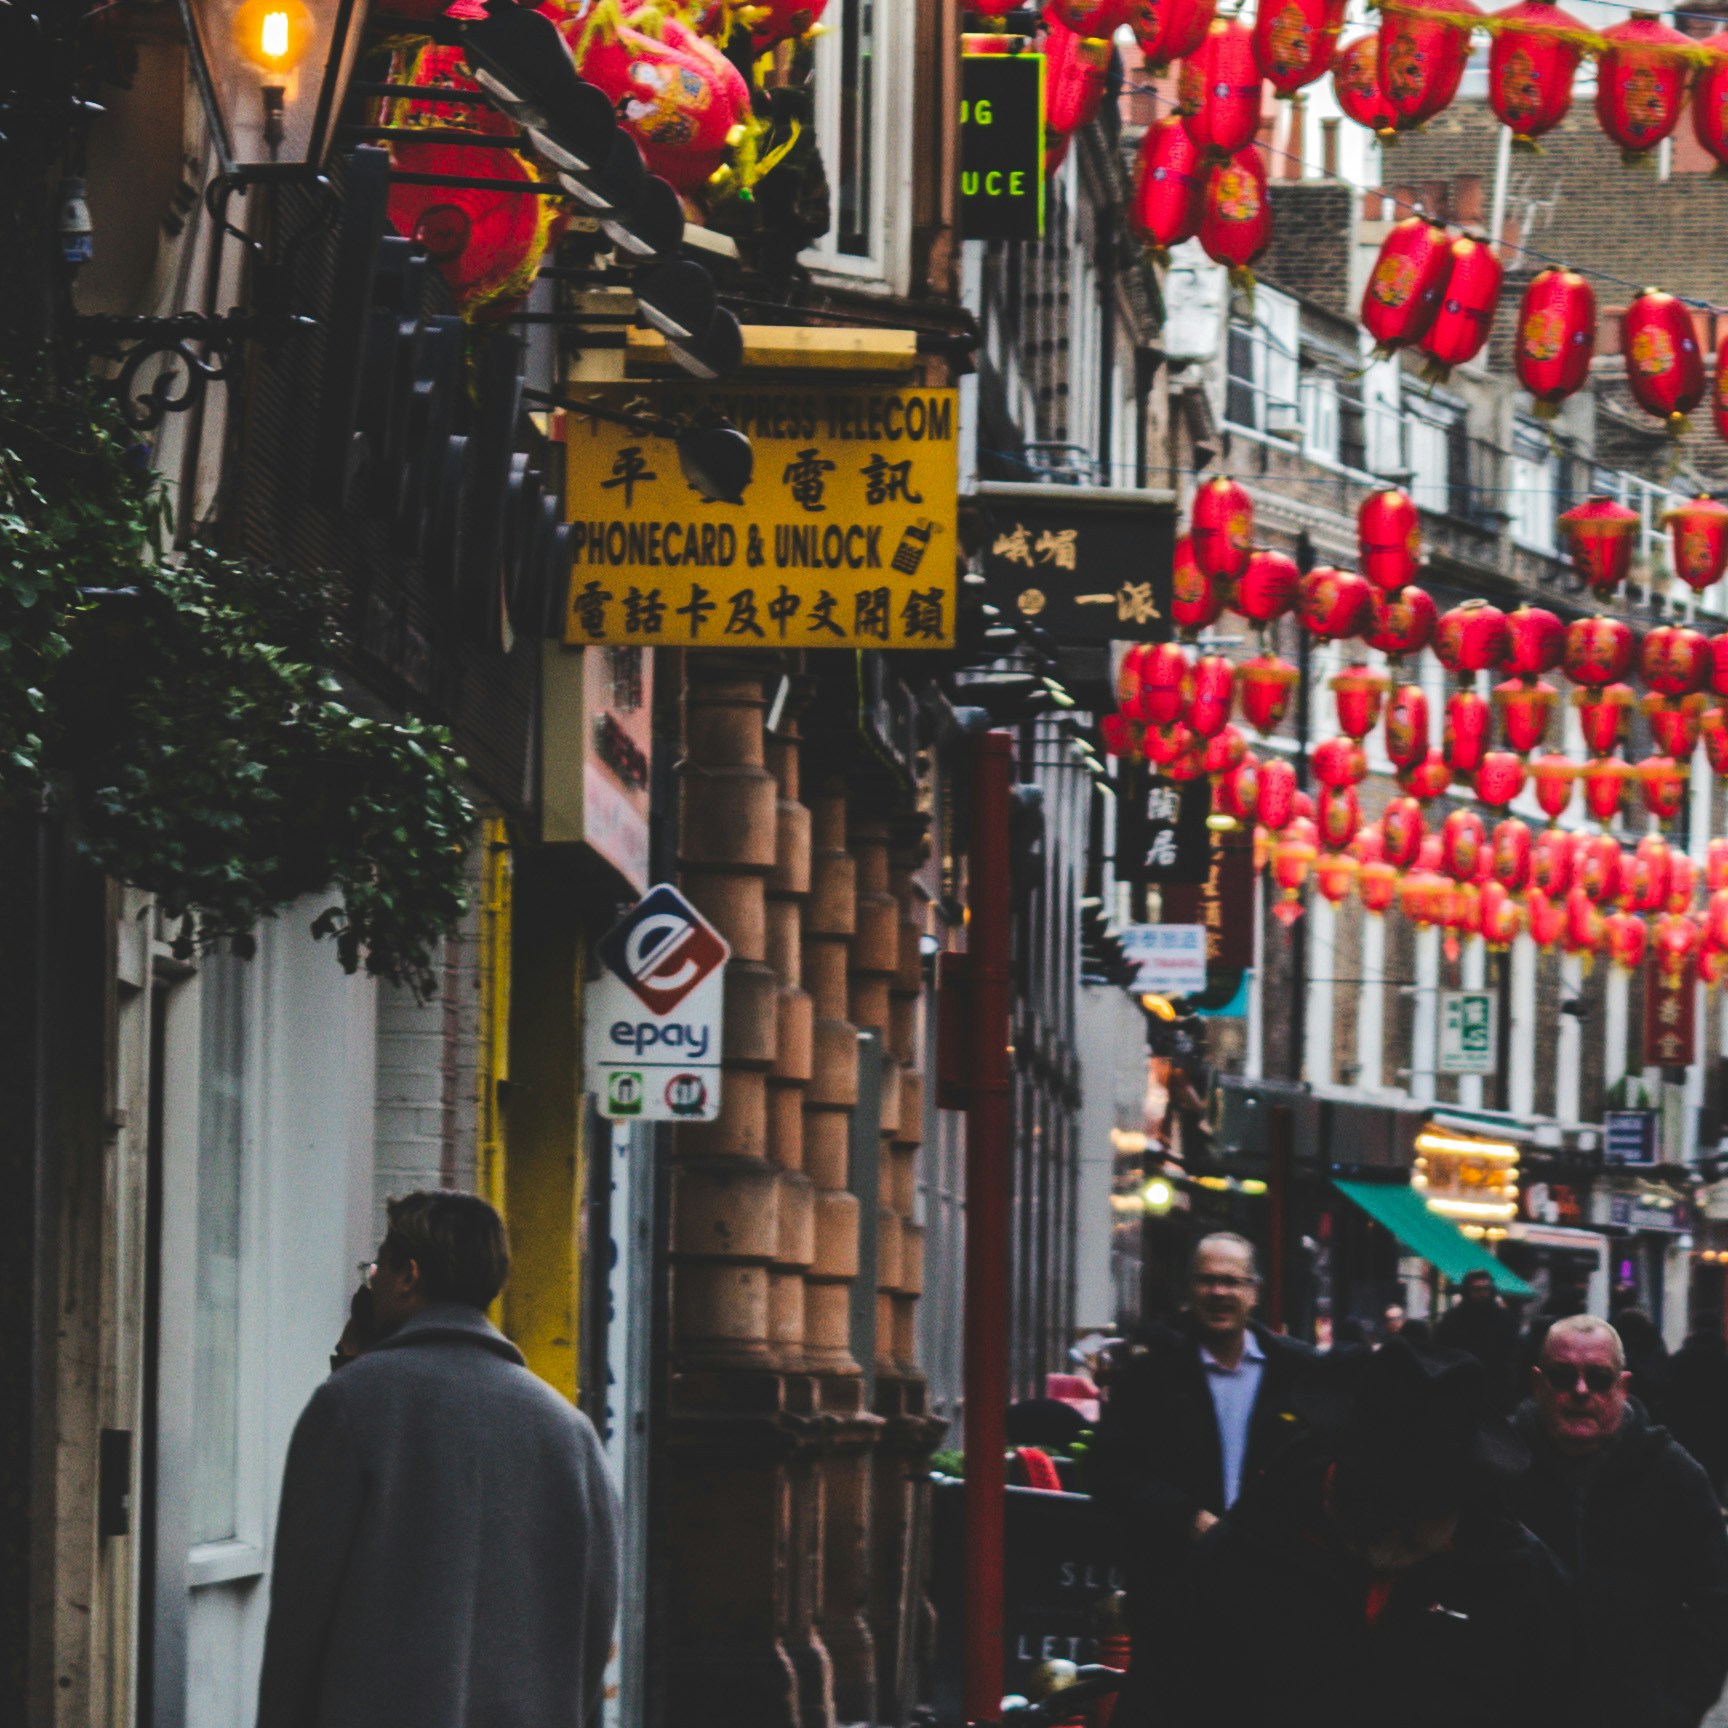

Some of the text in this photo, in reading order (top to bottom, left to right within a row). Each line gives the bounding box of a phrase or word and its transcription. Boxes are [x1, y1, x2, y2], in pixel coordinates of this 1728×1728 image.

[825, 394, 953, 441] TELECOM
[601, 445, 923, 513] 平電訊
[572, 520, 884, 570] PHONECARD & UNLOCK
[573, 580, 946, 641] 電話卡及中文開鎖
[609, 1021, 709, 1059] epay
